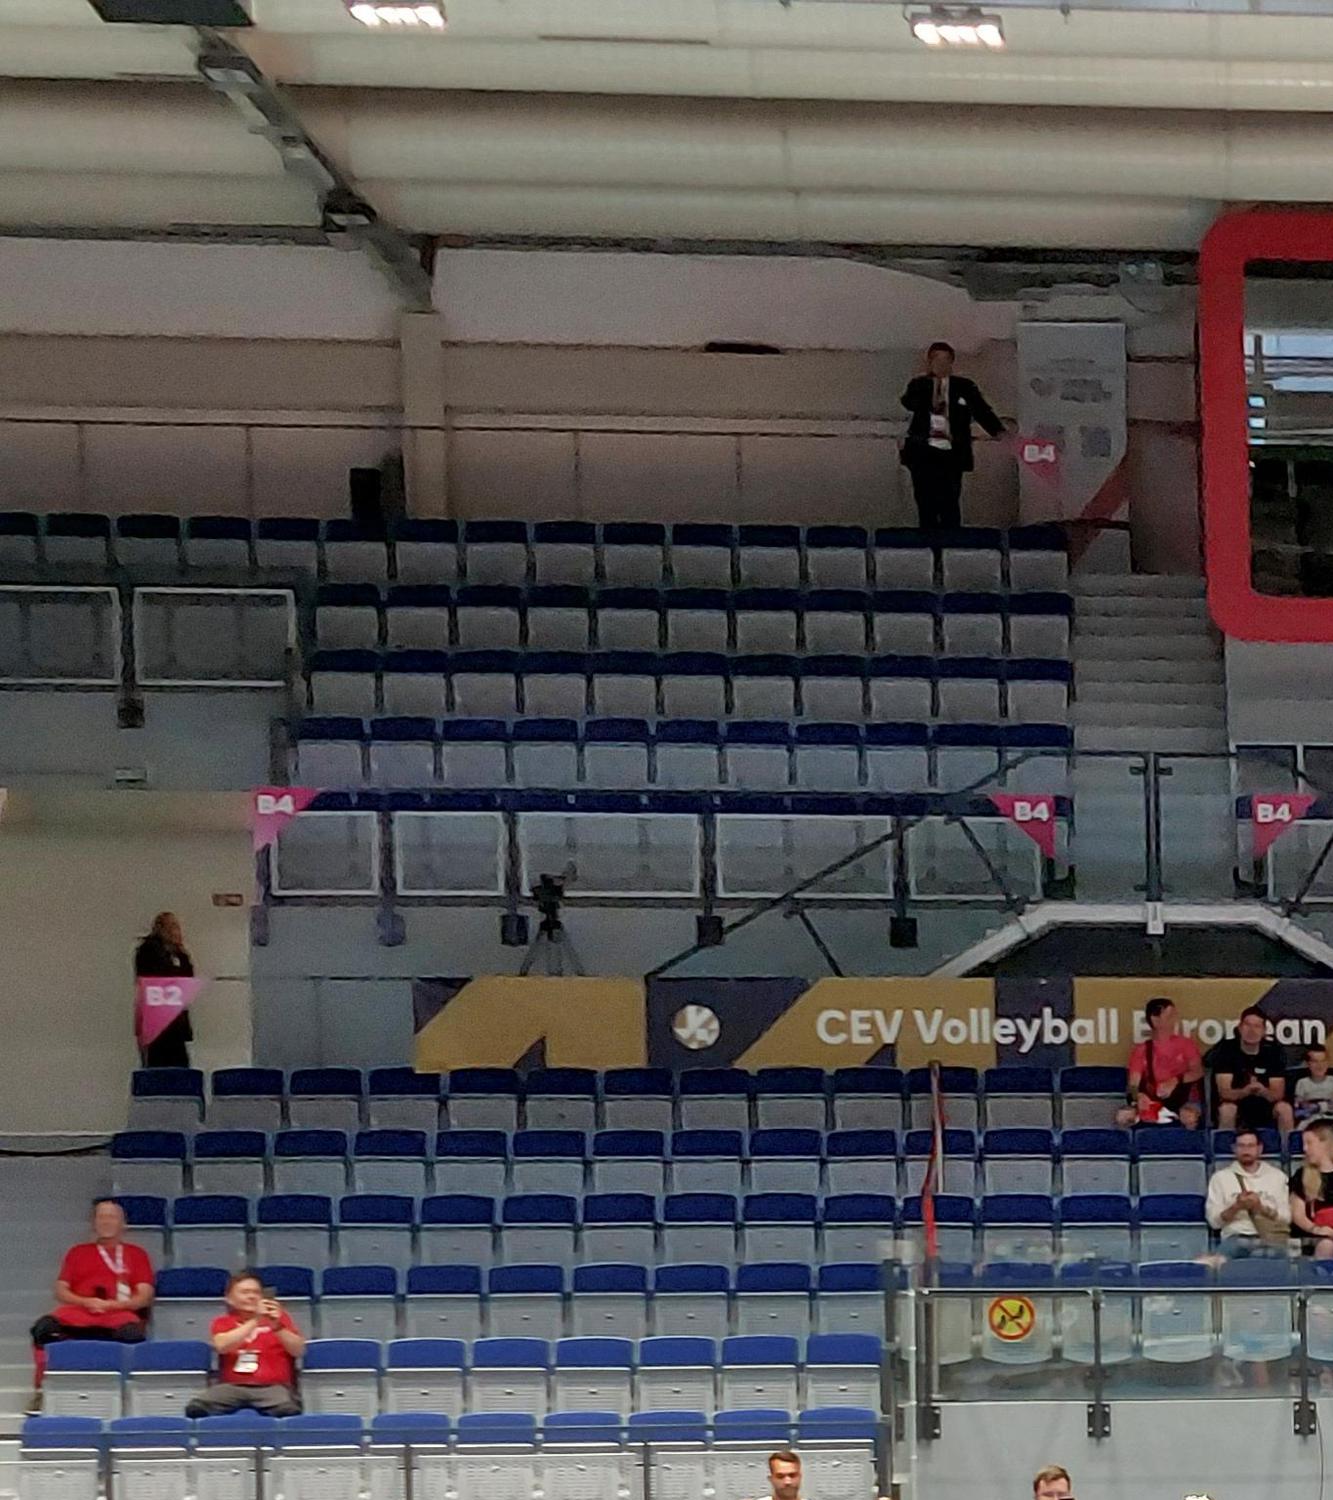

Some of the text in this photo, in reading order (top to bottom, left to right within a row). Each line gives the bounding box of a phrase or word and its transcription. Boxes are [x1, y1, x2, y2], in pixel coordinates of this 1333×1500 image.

[257, 795, 294, 814] B4
[1013, 802, 1049, 821] B4
[1257, 803, 1292, 823] B4
[145, 986, 182, 1005] B2
[816, 1009, 904, 1045] CEV
[914, 1007, 1120, 1053] Volleyball
